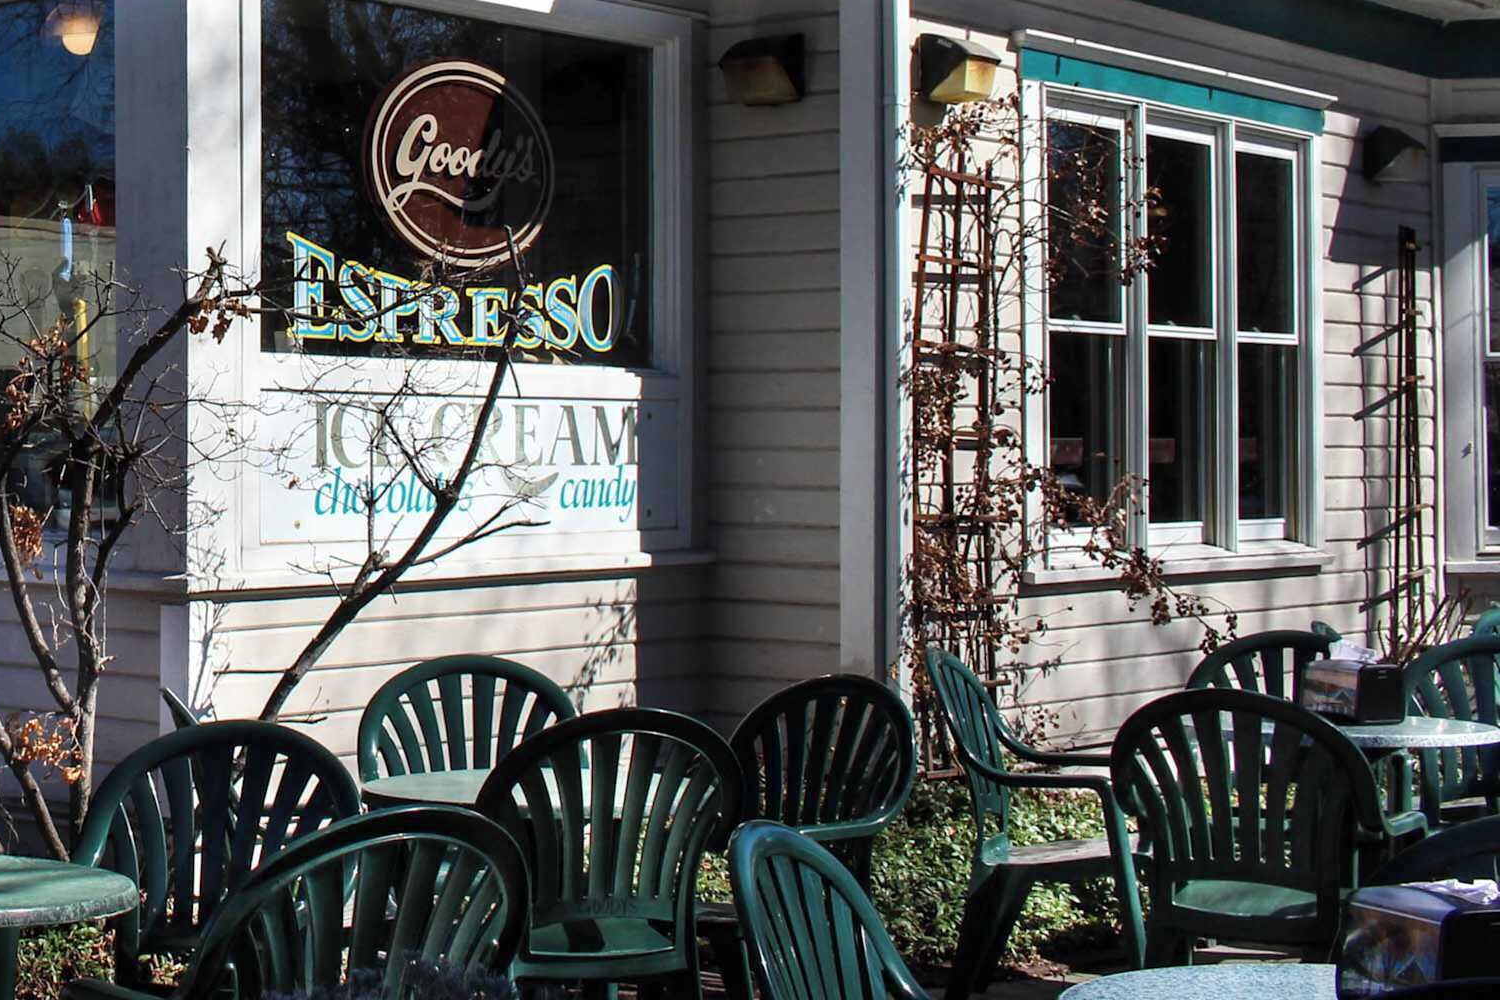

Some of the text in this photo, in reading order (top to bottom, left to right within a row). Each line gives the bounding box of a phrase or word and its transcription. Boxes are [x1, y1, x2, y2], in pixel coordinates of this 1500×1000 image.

[387, 113, 538, 212] Goody's
[286, 230, 624, 352] ESPRESSO
[431, 402, 639, 467] CREAM
[560, 463, 637, 523] candy
